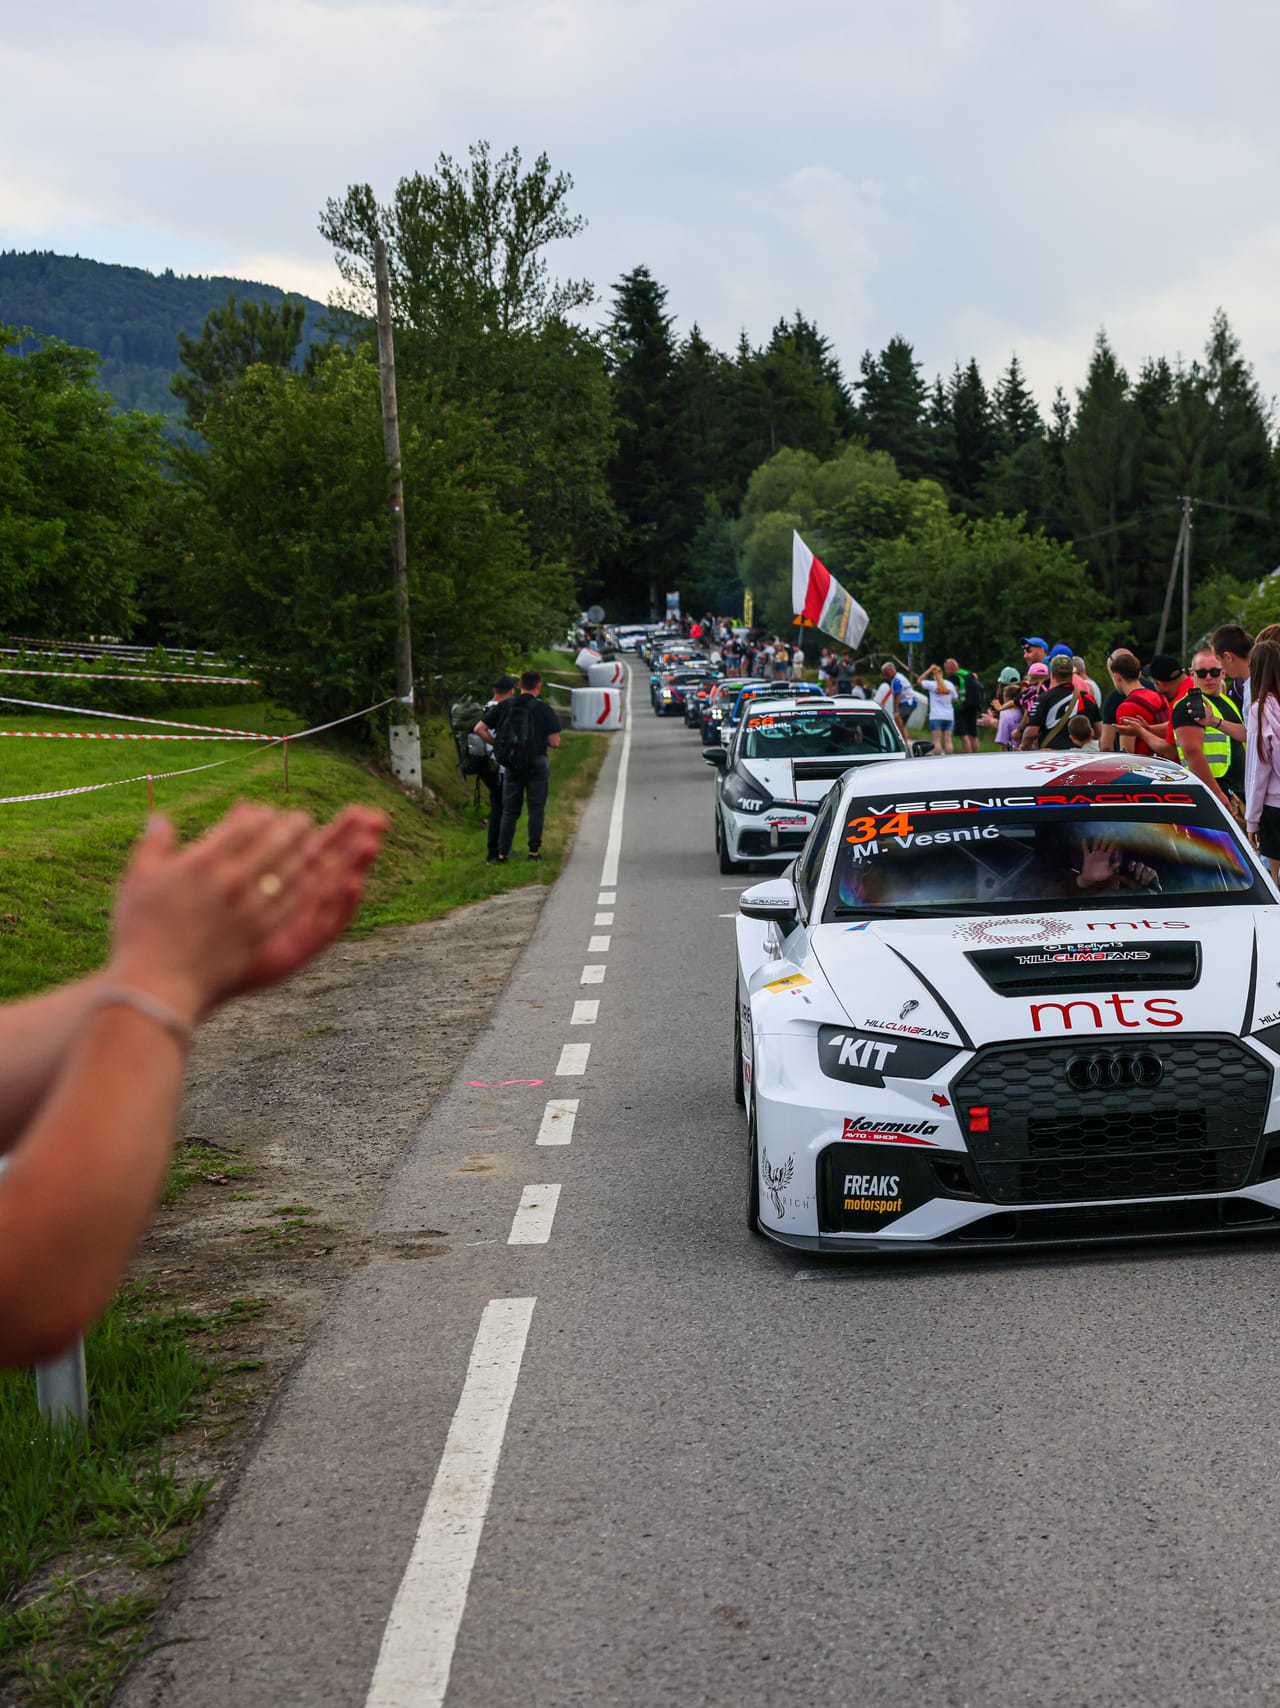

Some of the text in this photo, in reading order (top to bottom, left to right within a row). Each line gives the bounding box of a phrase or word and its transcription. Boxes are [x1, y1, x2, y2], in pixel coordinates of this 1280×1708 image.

[742, 799, 763, 811] KIT
[867, 793, 1194, 816] VESNICRACING
[846, 813, 915, 844] 34
[853, 824, 1000, 859] M. Vesnić
[1087, 919, 1190, 931] mts
[1015, 951, 1151, 965] HILLCLIMBFANS
[1030, 993, 1184, 1032] mts
[864, 1018, 950, 1040] HILLCLIMBFANS
[838, 1036, 898, 1071] KIT
[848, 1116, 940, 1136] formula
[843, 1175, 900, 1197] FREAKS
[844, 1197, 903, 1214] motorsport
